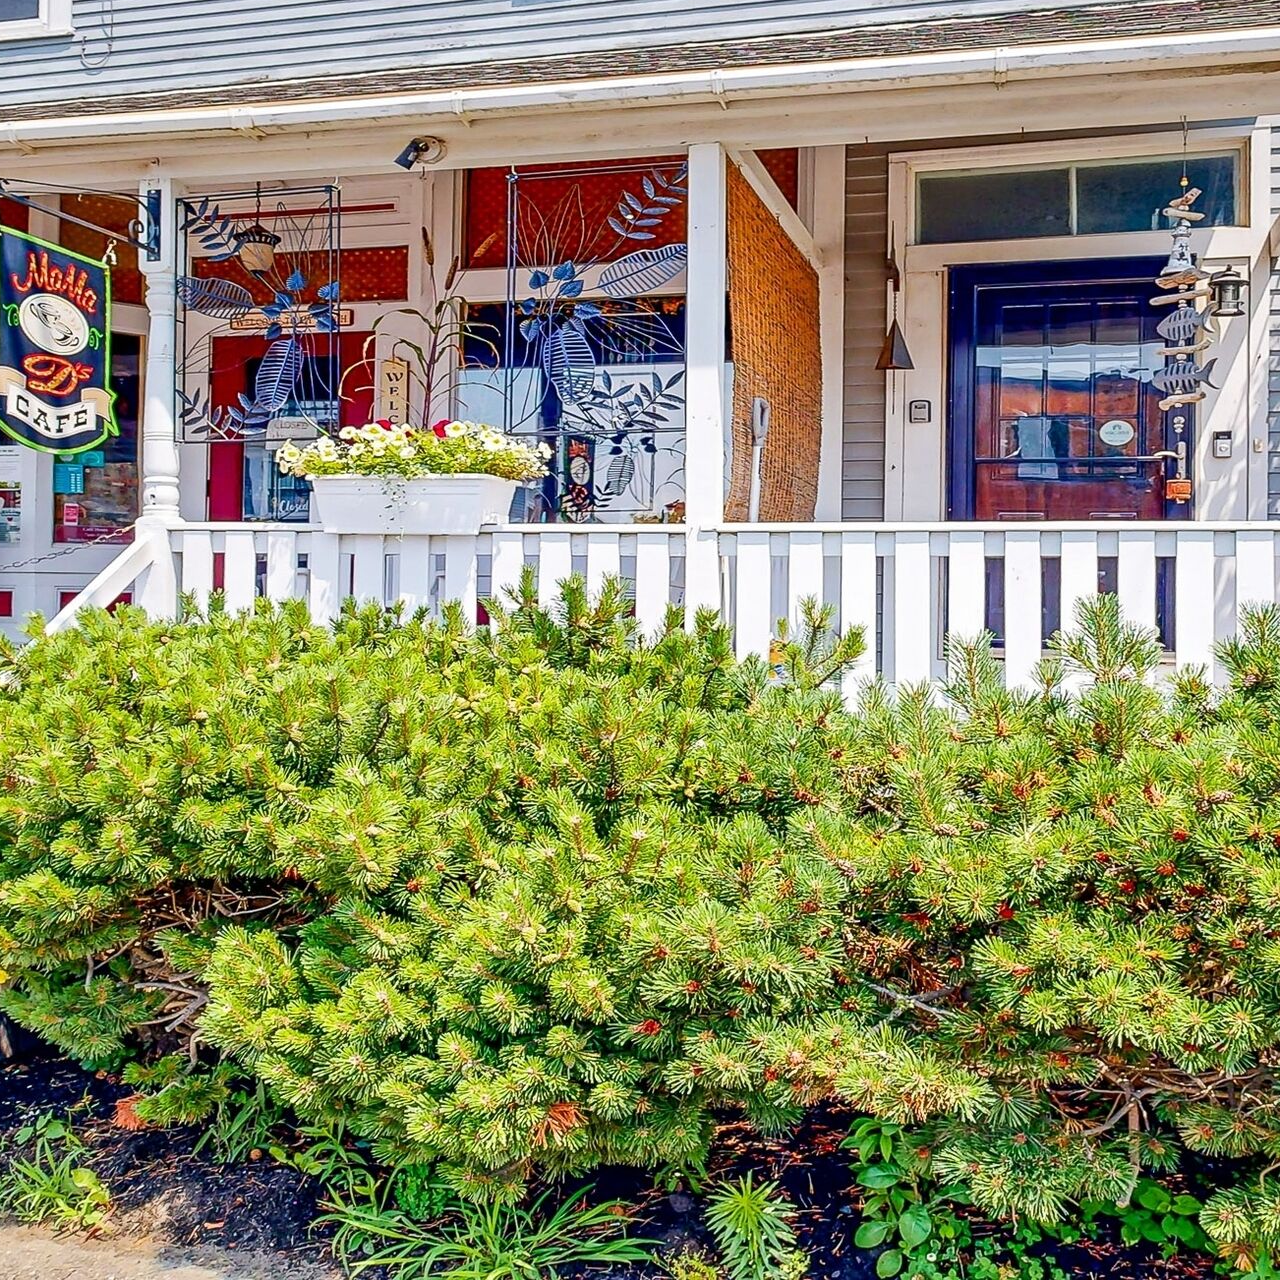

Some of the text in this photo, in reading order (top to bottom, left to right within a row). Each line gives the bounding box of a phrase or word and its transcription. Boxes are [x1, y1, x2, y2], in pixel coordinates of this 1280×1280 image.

[23, 354, 94, 396] D's
[16, 394, 88, 433] CAFÉ
[279, 500, 309, 513] Closed
